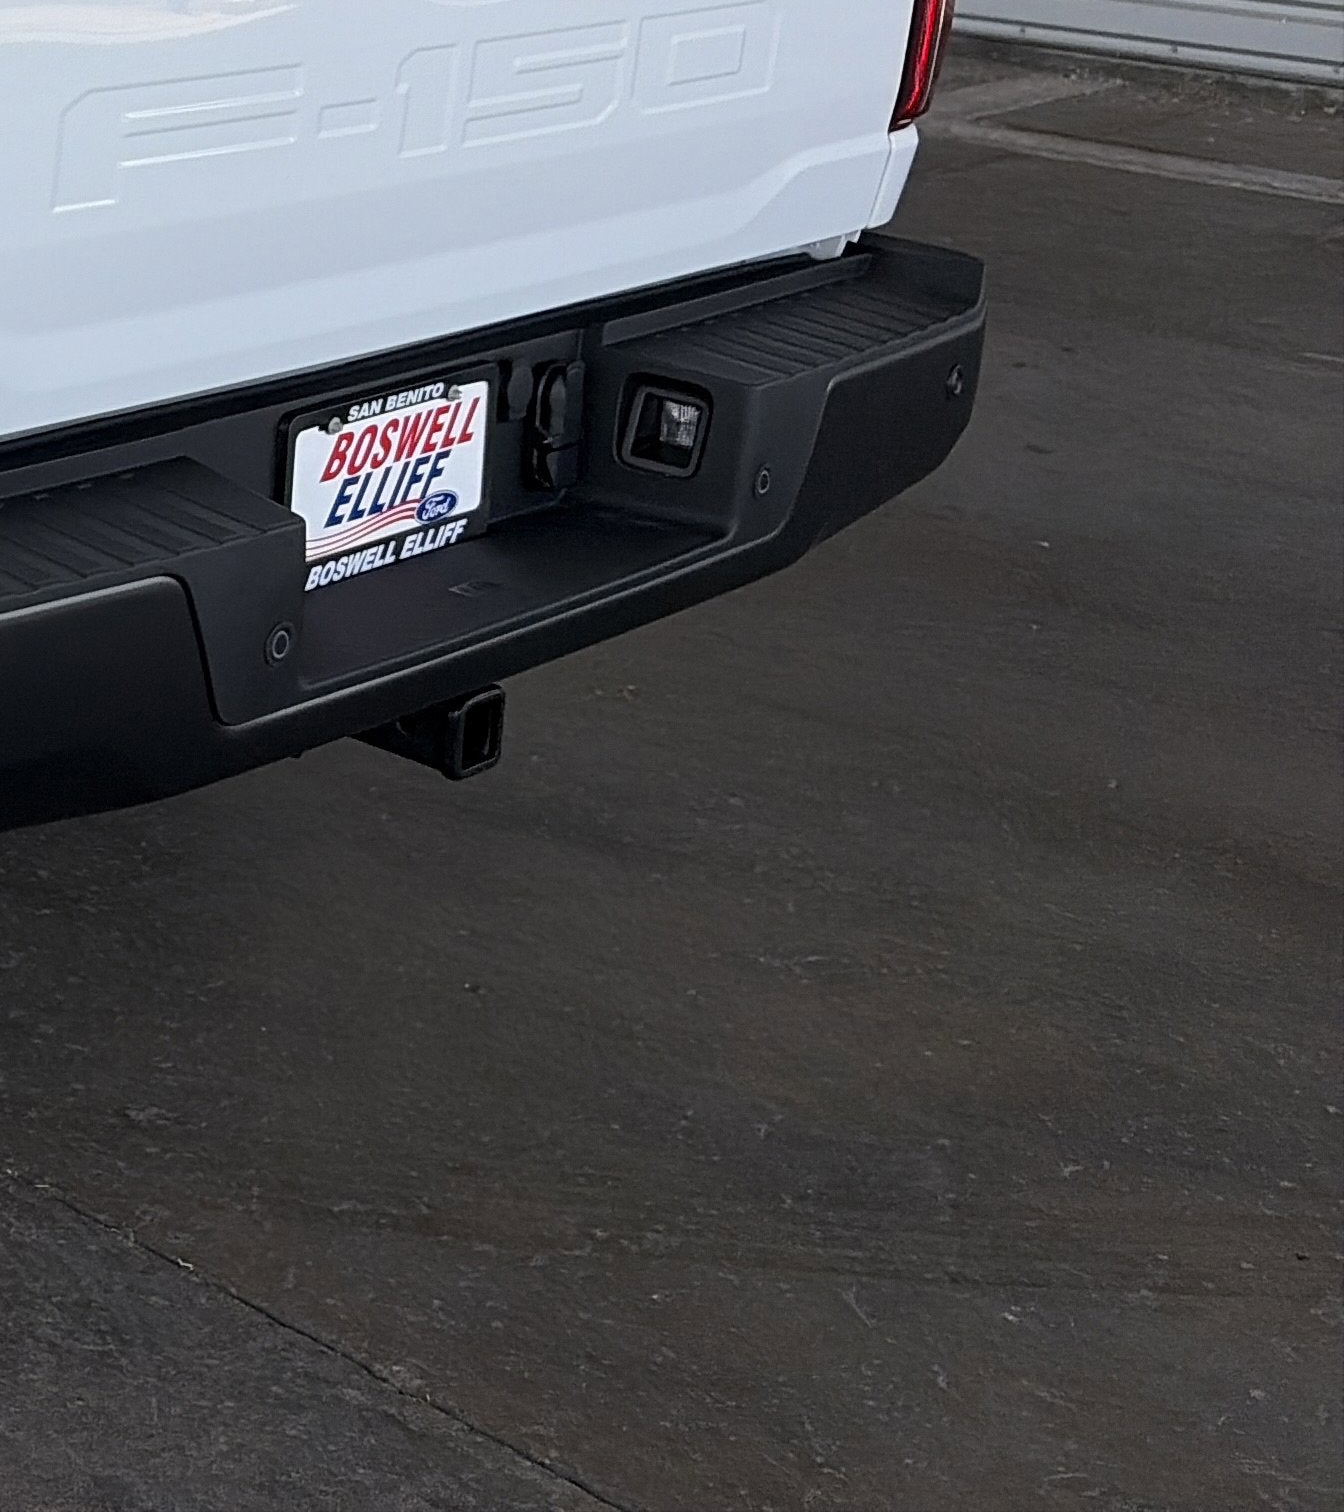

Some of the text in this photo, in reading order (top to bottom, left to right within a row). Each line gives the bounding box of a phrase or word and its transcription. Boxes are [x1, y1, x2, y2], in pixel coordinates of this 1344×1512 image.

[347, 382, 445, 421] SAN BENITO
[319, 397, 481, 483] BOSWELL
[323, 449, 452, 528] ELLIFF
[421, 494, 451, 521] Ford
[304, 518, 468, 592] BOSWELL ELLIFF
